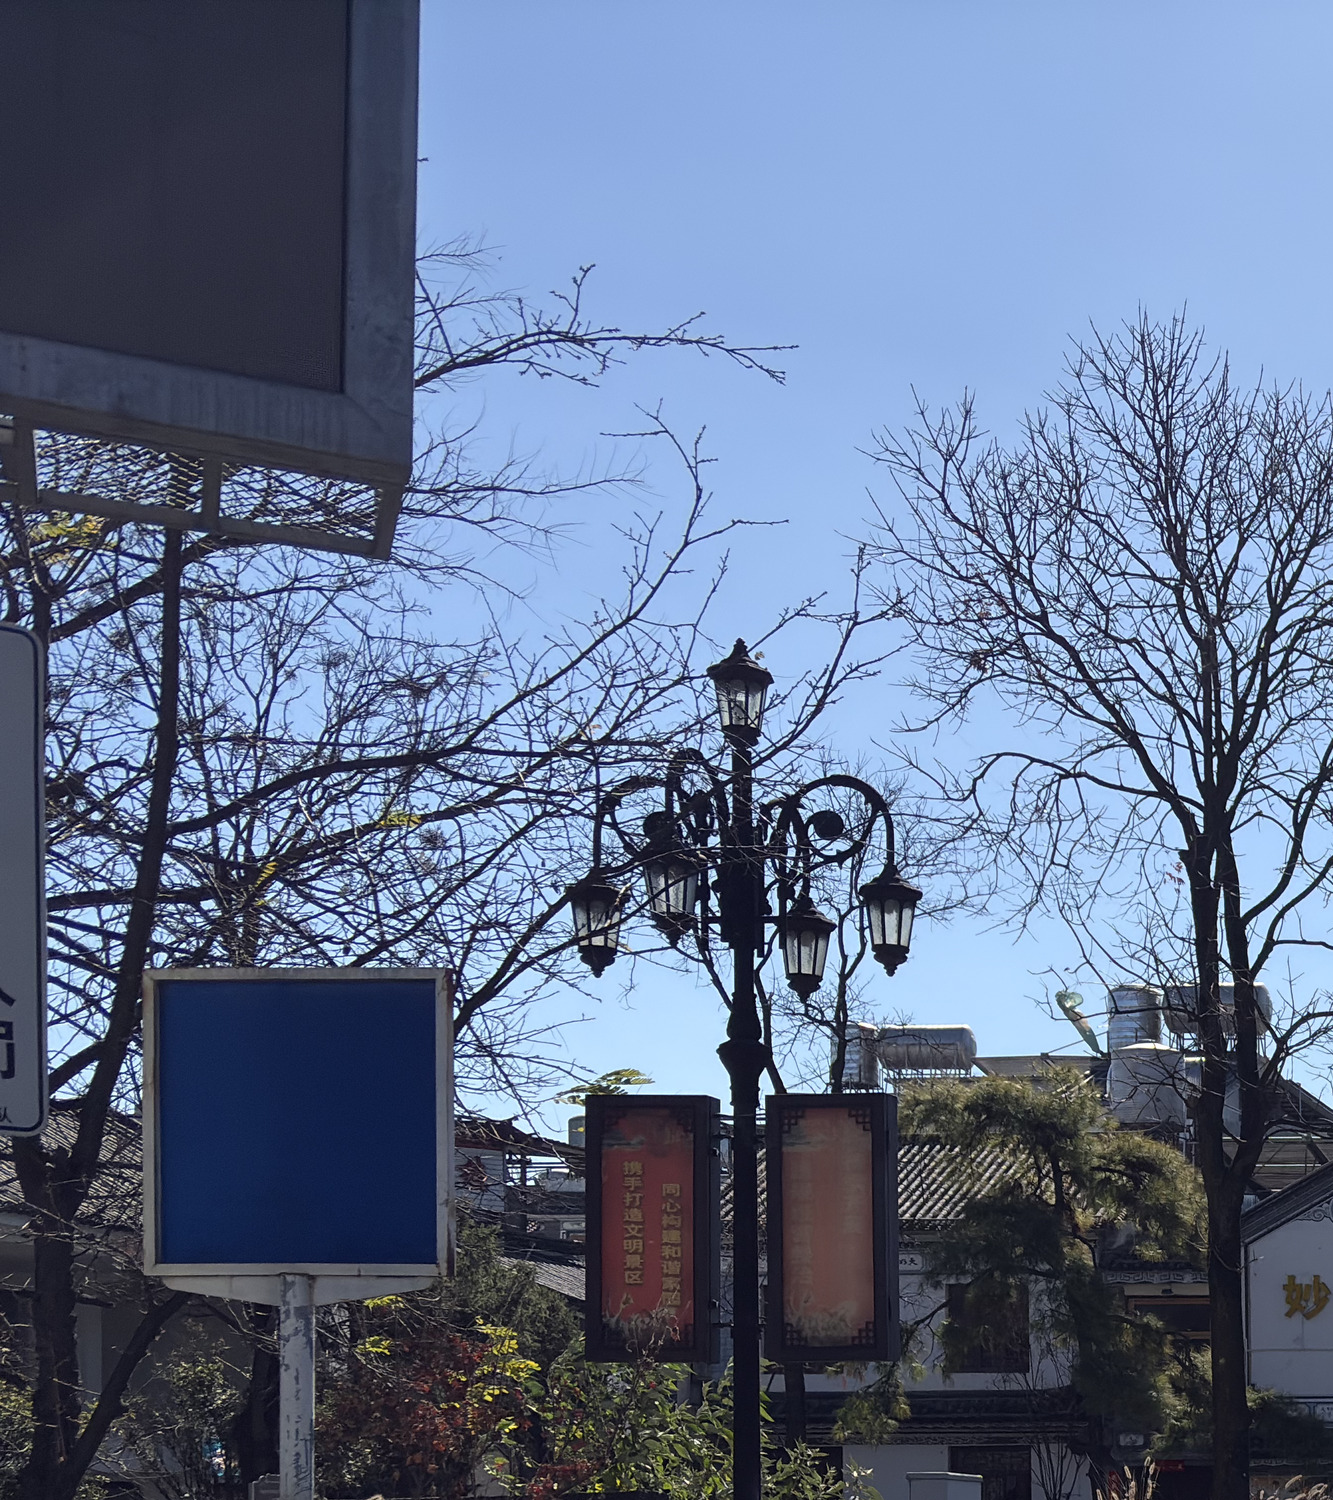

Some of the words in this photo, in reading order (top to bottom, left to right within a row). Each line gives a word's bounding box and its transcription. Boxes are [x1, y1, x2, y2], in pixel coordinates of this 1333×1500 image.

[623, 1160, 644, 1285] 携手打造文明景区
[662, 1183, 682, 1308] 同心构建和谐家园
